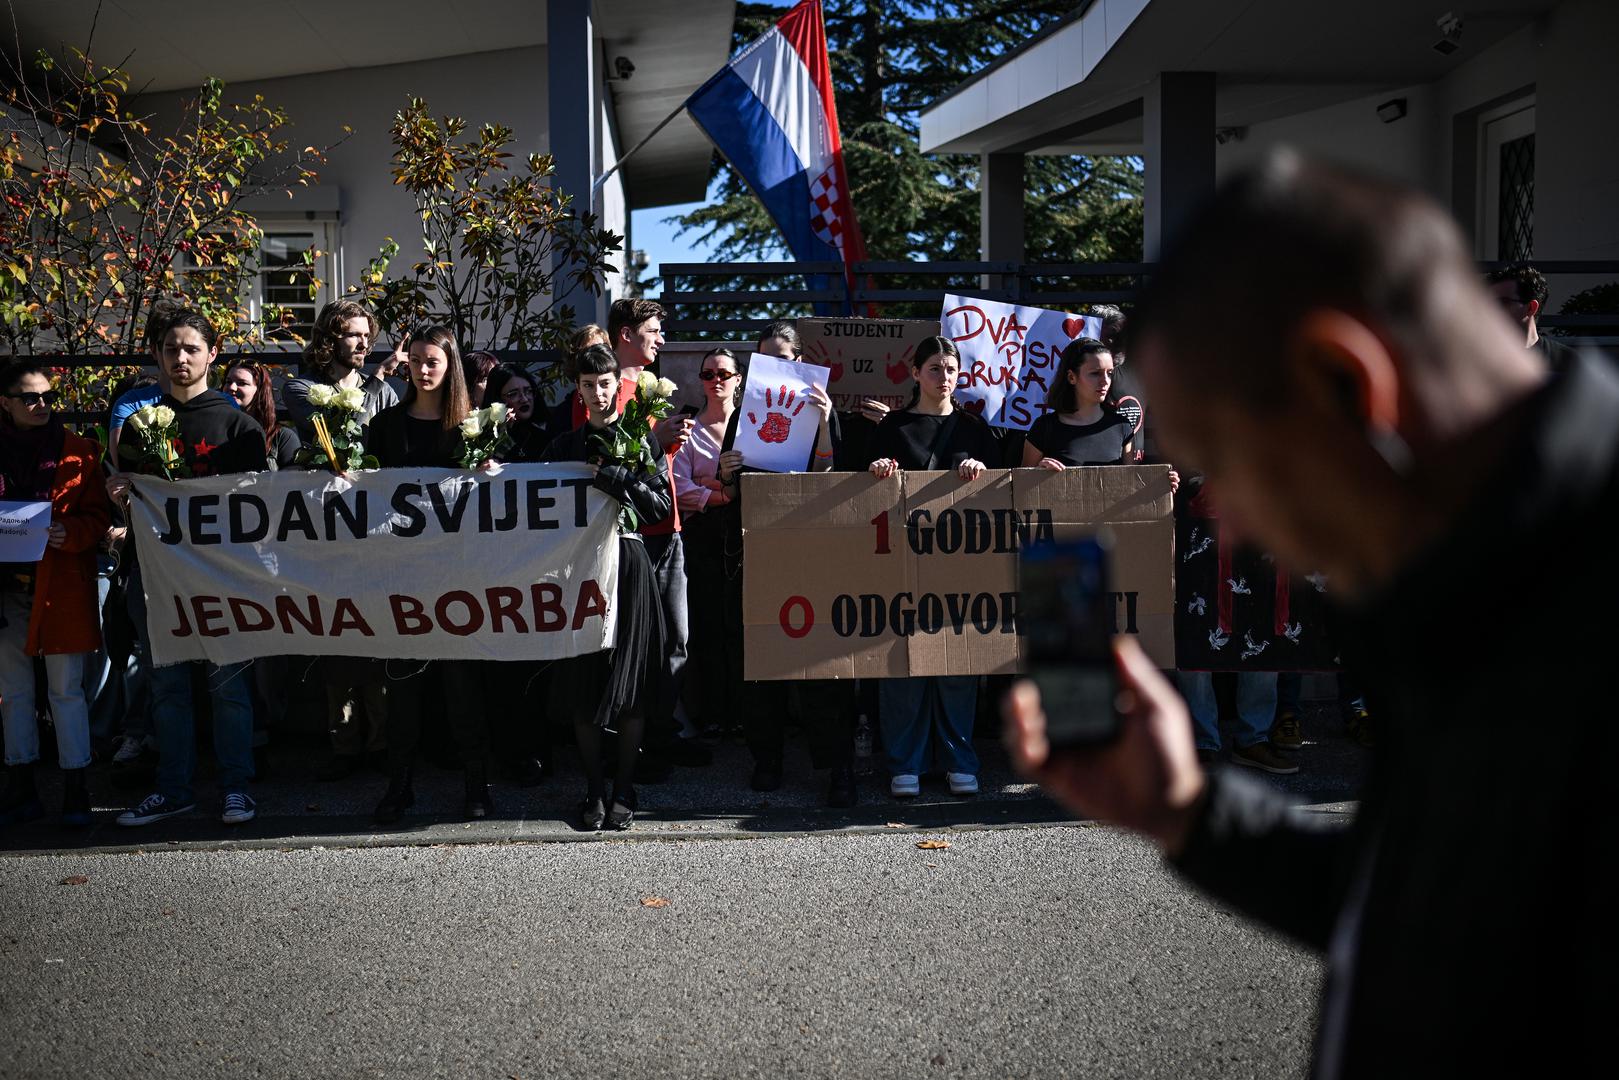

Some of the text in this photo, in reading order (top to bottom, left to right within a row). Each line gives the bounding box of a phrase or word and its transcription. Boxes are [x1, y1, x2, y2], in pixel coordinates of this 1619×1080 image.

[823, 322, 905, 338] STUDENTI
[945, 305, 1027, 345] DVA
[852, 359, 874, 373] UZ
[956, 361, 1048, 393] ORUKA
[1001, 397, 1054, 426] IST
[160, 477, 595, 545] JEDAN SVIJET
[870, 508, 1055, 555] 1 GODINA
[171, 578, 608, 637] JEDNA BORBA
